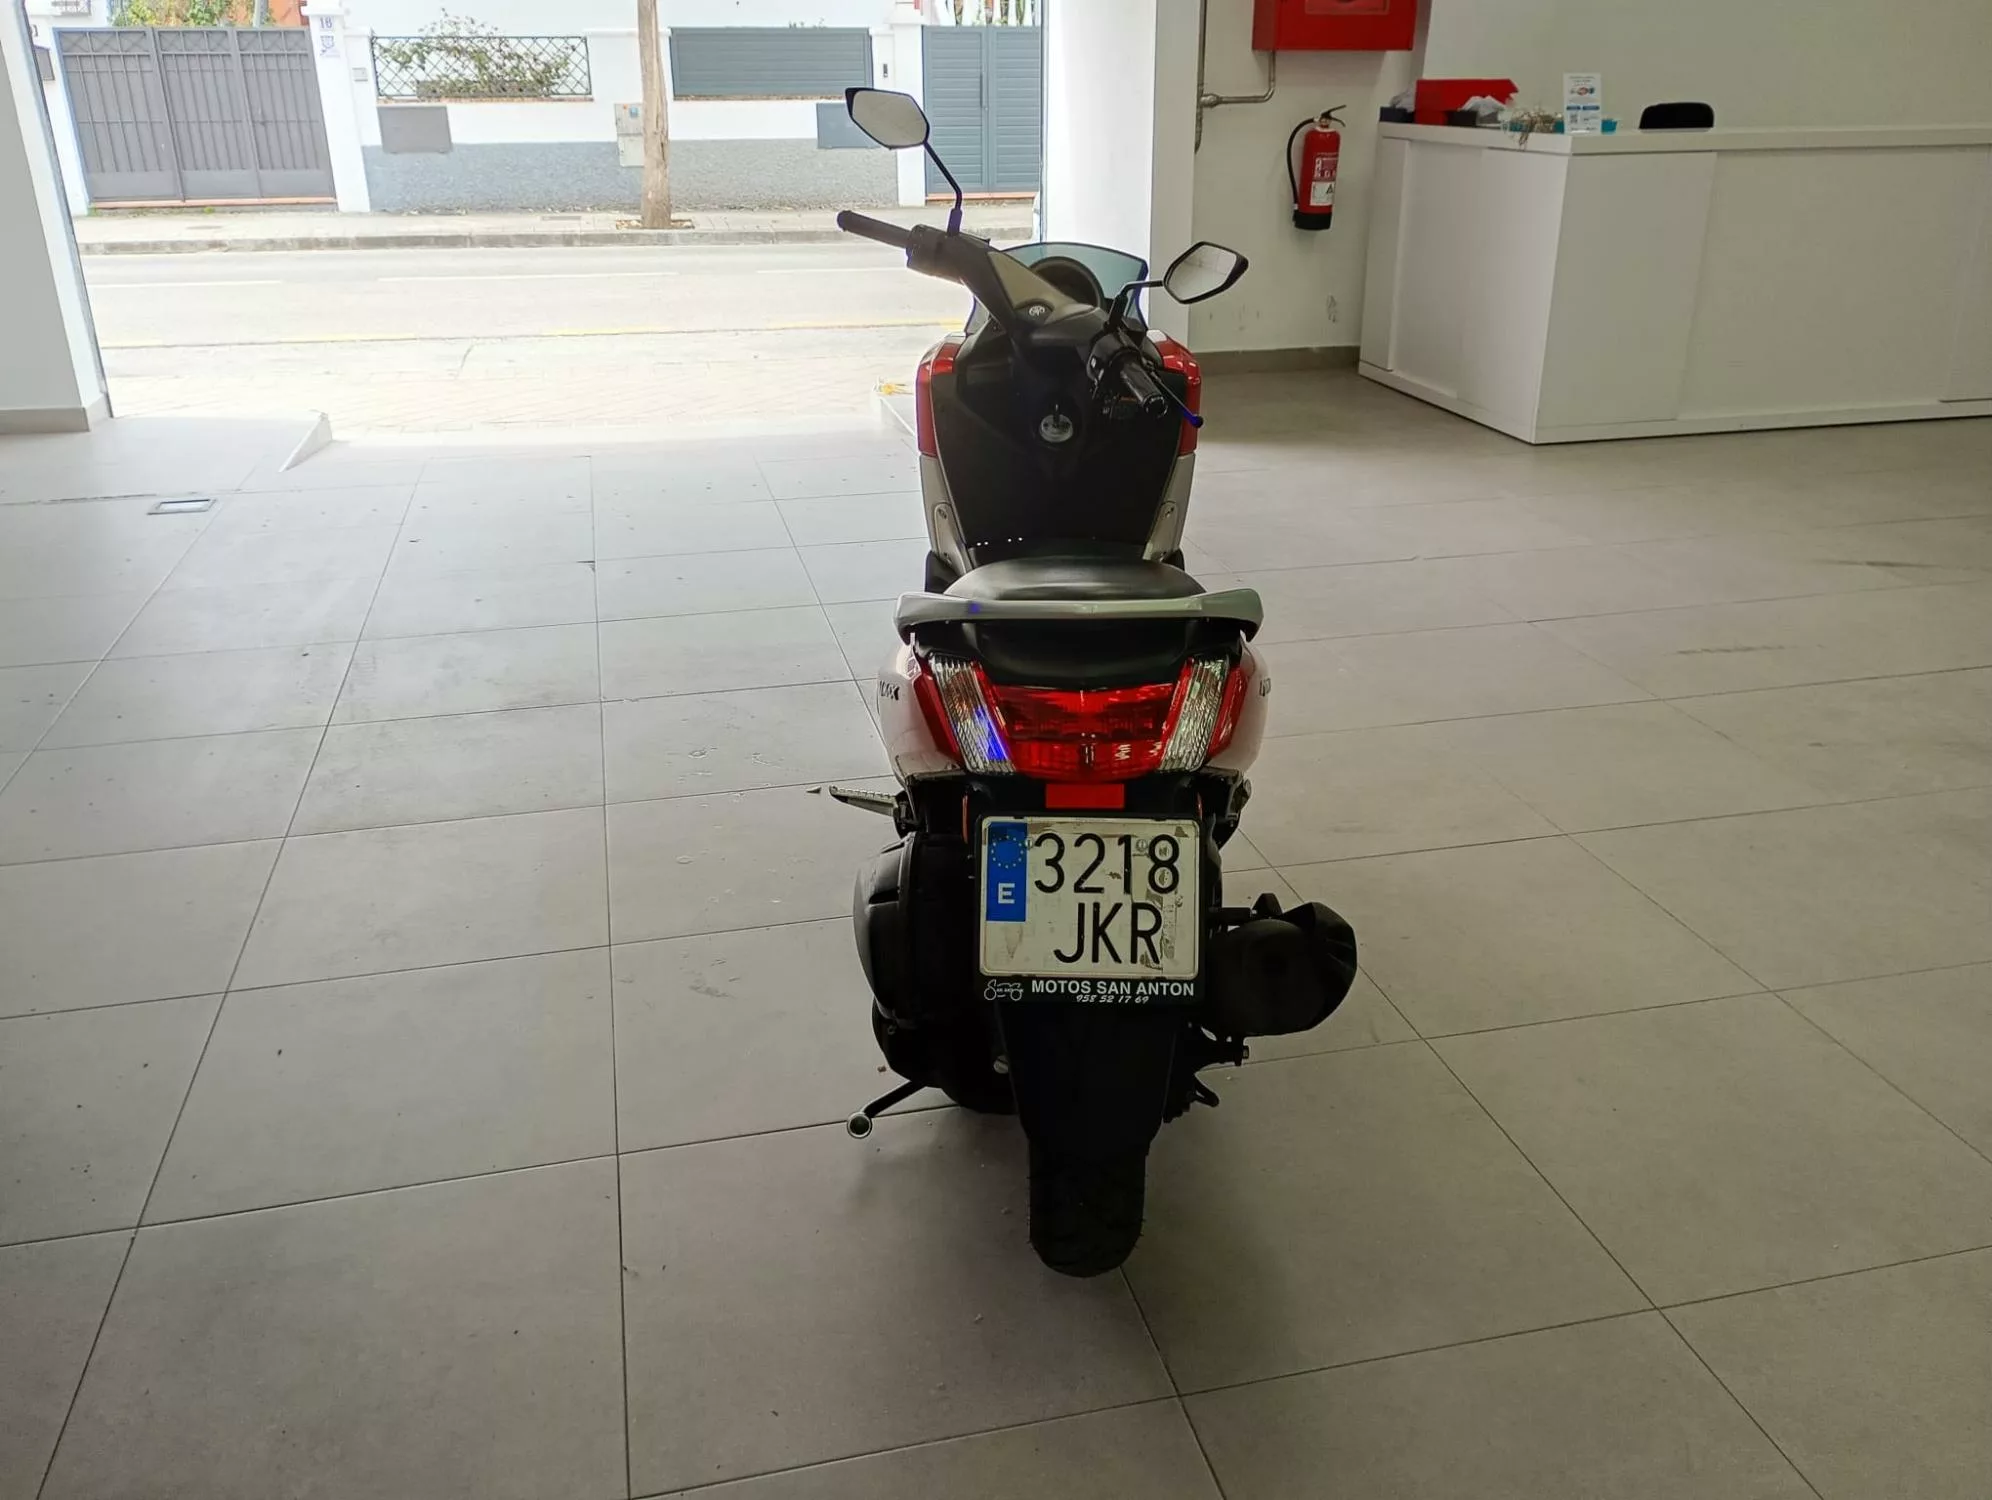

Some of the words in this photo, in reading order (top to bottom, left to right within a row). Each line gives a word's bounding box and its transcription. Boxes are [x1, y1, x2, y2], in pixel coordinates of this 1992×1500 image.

[1034, 832, 1180, 895] 3218
[997, 882, 1016, 905] E
[1053, 901, 1162, 965] JKR
[1031, 979, 1092, 994] MOTOS
[1096, 980, 1131, 995] SAN
[1136, 981, 1195, 996] ANTON
[1099, 994, 1115, 1003] 52
[1118, 995, 1132, 1004] 17
[1135, 995, 1149, 1004] 69
